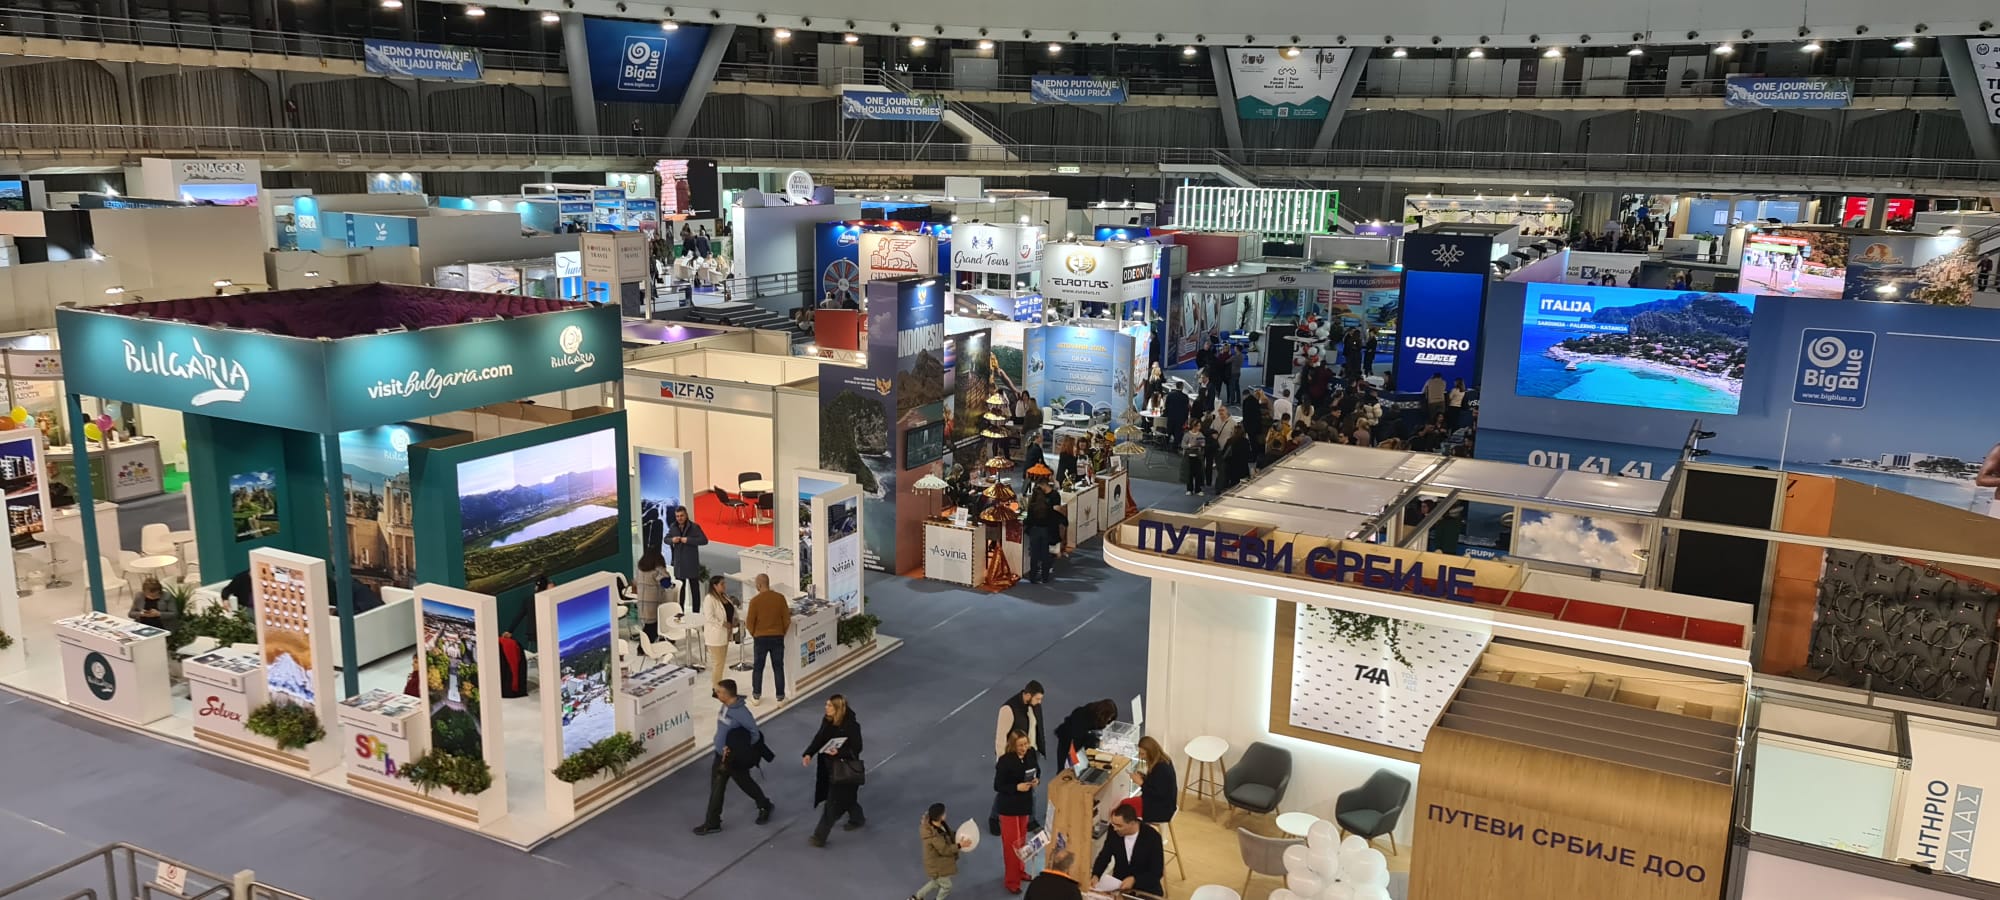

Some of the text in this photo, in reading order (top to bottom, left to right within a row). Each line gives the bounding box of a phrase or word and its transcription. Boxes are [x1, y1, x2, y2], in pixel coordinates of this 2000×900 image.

[378, 44, 413, 58] JEDNO
[393, 57, 434, 71] HILJADU
[645, 50, 661, 79] Blue
[625, 65, 645, 82] Big
[1042, 80, 1070, 88] JEDNO
[1753, 82, 1828, 92] ONE JOURNEY
[1052, 88, 1086, 97] HILJADU
[1731, 92, 1848, 100] A THOUSAND STORIES
[864, 96, 924, 107] ONE JOURNEY
[856, 106, 904, 115] THOUSAND
[905, 106, 940, 116] STORIES
[954, 250, 984, 269] Grand
[985, 253, 1010, 267] Tours
[1124, 267, 1144, 282] ODEON
[1597, 267, 1632, 275] БЕОГРАДСК
[1053, 278, 1109, 289] EUROTURS
[1540, 298, 1592, 314] ITALIJA
[1570, 322, 1596, 330] PALERMO
[898, 323, 944, 358] INDONESIA
[1405, 336, 1470, 351] USKORO
[1838, 348, 1864, 389] Blue
[1804, 369, 1839, 392] Big
[1802, 392, 1856, 402] www.bigblue.rs
[1528, 450, 1570, 470] 011
[1578, 456, 1610, 474] 41
[1620, 460, 1652, 479] 41
[933, 544, 968, 561] Asvinia
[1138, 518, 1476, 604] ПУТЕВИ СРБИЈЕ
[1354, 664, 1390, 687] T4A
[200, 696, 240, 721] Solvex
[640, 710, 690, 743] BOHEMIA
[356, 733, 399, 777] SOFIA
[1916, 780, 1949, 864] ΗΤΗΡΙΟ
[1428, 804, 1706, 884] ПУТЕВИ СРБИЈЕ ДОО
